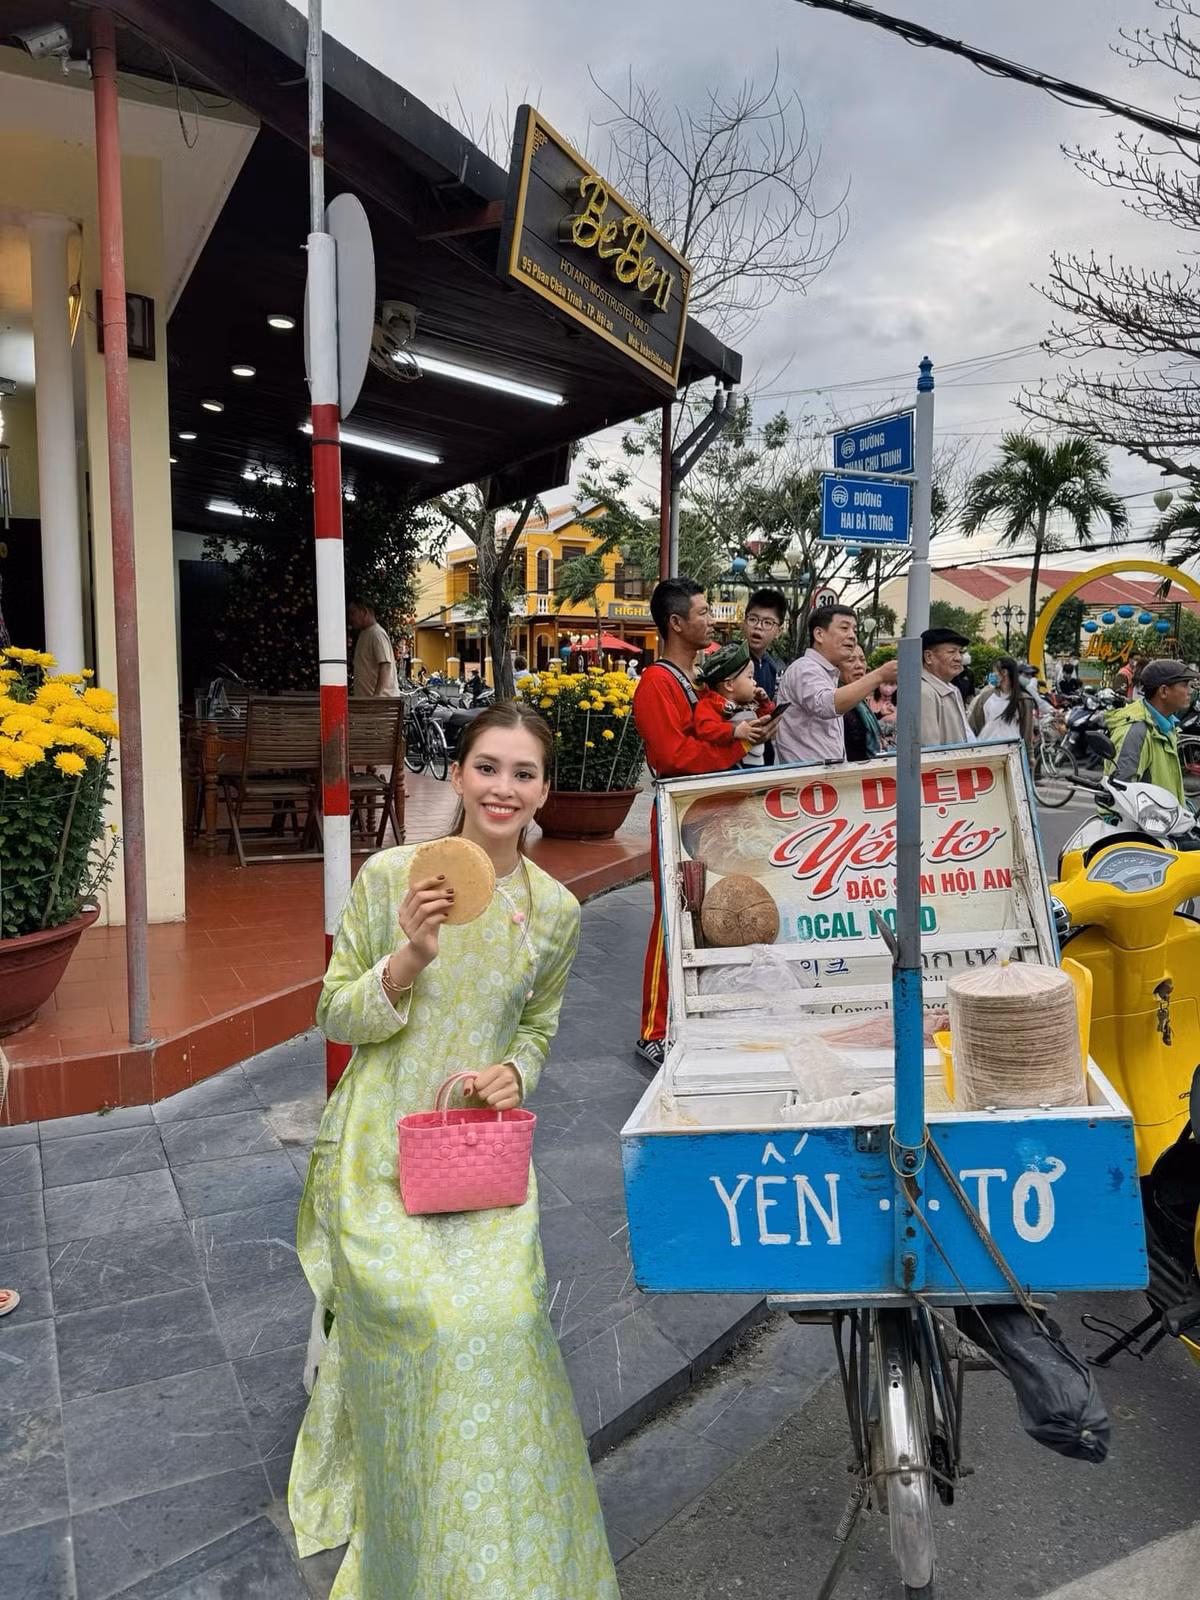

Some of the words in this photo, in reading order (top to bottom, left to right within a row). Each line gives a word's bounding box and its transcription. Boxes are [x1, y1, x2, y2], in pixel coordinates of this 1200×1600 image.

[522, 255, 532, 273] 95
[532, 263, 550, 287] Phan
[590, 281, 607, 303] MOST
[606, 292, 634, 324] TRUSTED
[880, 448, 902, 469] TRINH
[840, 512, 854, 529] HAI
[856, 511, 867, 530] BÀ
[614, 607, 652, 617] HIGHL
[820, 595, 834, 607] 30
[764, 781, 838, 818] CÔ
[861, 767, 994, 815] DỆP
[931, 819, 1001, 858] tơ
[846, 876, 887, 903] ĐẶC
[940, 868, 975, 896] HỘI
[983, 868, 1012, 890] AN
[869, 906, 937, 935] FOD
[709, 1133, 841, 1246] YẾN
[959, 1156, 1067, 1243] TƠ
